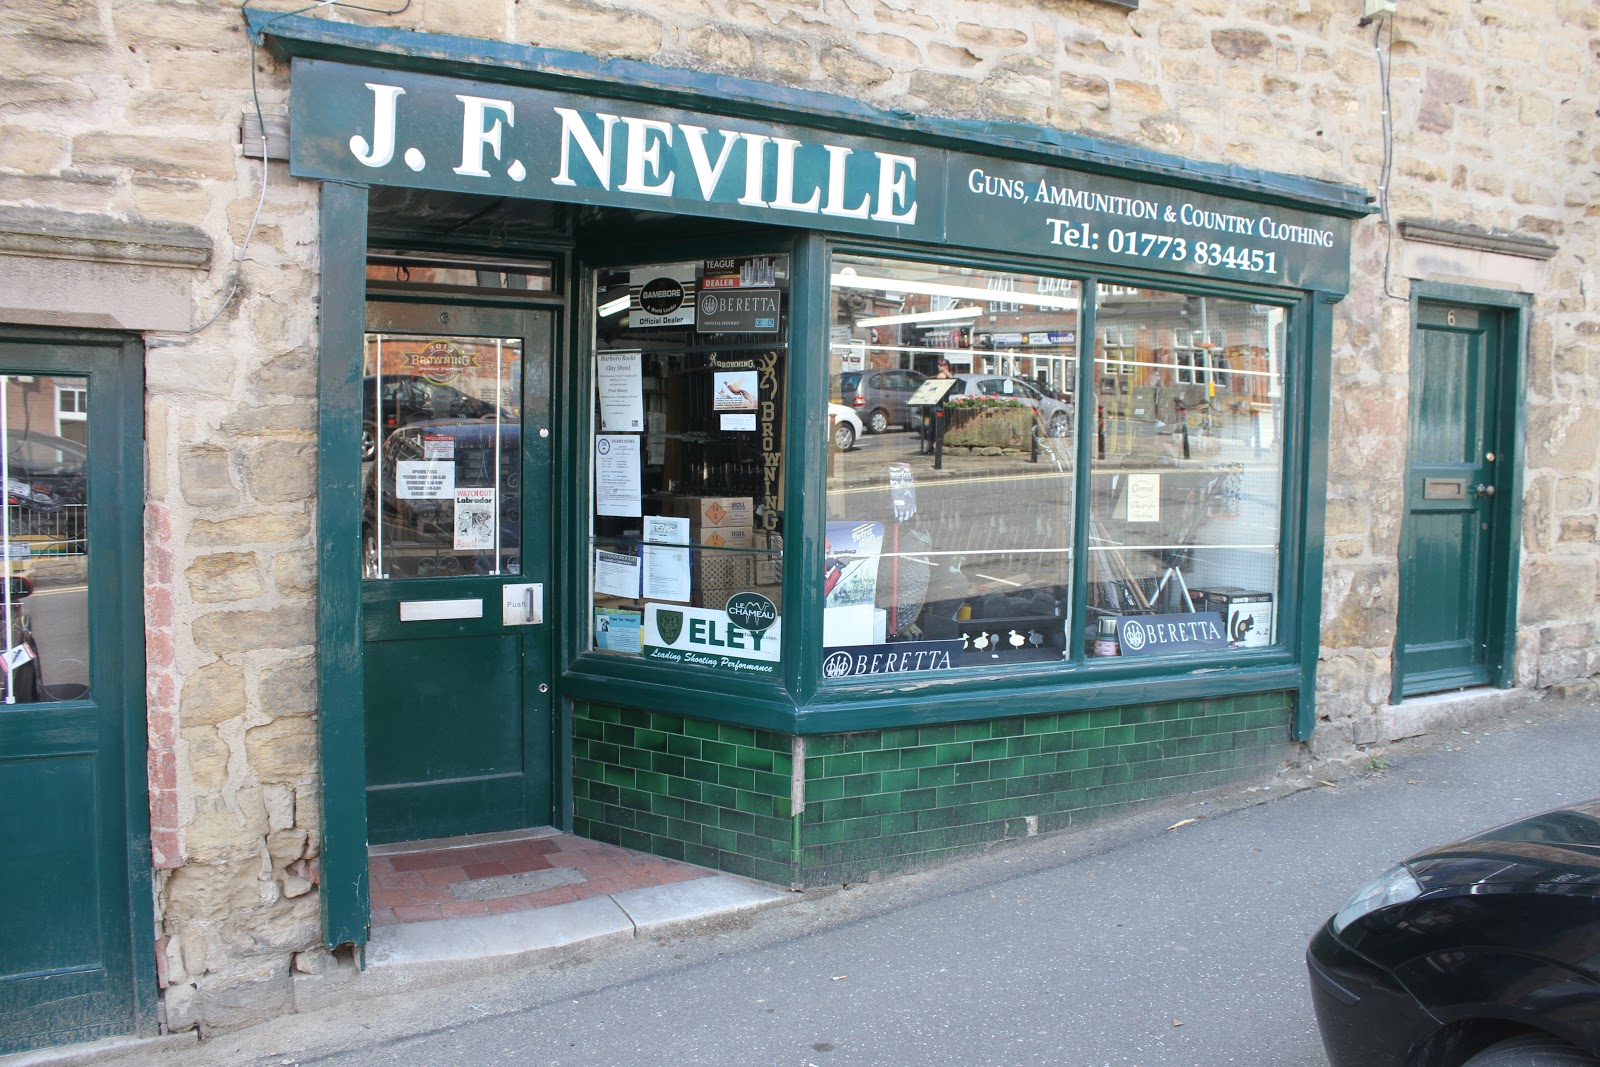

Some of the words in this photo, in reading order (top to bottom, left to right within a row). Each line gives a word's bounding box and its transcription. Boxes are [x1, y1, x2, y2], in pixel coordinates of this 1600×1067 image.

[349, 82, 426, 172] J.
[452, 93, 527, 183] F.
[551, 106, 918, 226] NEVILLE
[1163, 204, 1177, 223] &
[1046, 217, 1099, 251] Tel:
[1107, 228, 1187, 262] 01773
[1193, 241, 1277, 274] 834451
[706, 259, 735, 269] TEAGUE
[706, 278, 734, 287] DEALER
[642, 289, 681, 299] GAMEBORE
[720, 297, 776, 312] BERETTA
[639, 317, 661, 325] Official
[663, 316, 684, 324] Dealer
[1447, 309, 1456, 326] 6
[411, 354, 471, 366] BROWNING
[716, 360, 754, 368] BROWNING
[761, 401, 781, 531] BROWNING
[456, 538, 477, 548] About!
[852, 528, 873, 543] Tetra
[859, 534, 875, 547] Gun
[728, 607, 774, 619] CHAMEAU
[690, 618, 767, 651] ELEY
[1146, 621, 1222, 644] BERETTA
[651, 648, 682, 662] Leading
[684, 653, 718, 668] Shooting
[720, 657, 773, 673] Performance
[855, 650, 951, 675] BERETTA
